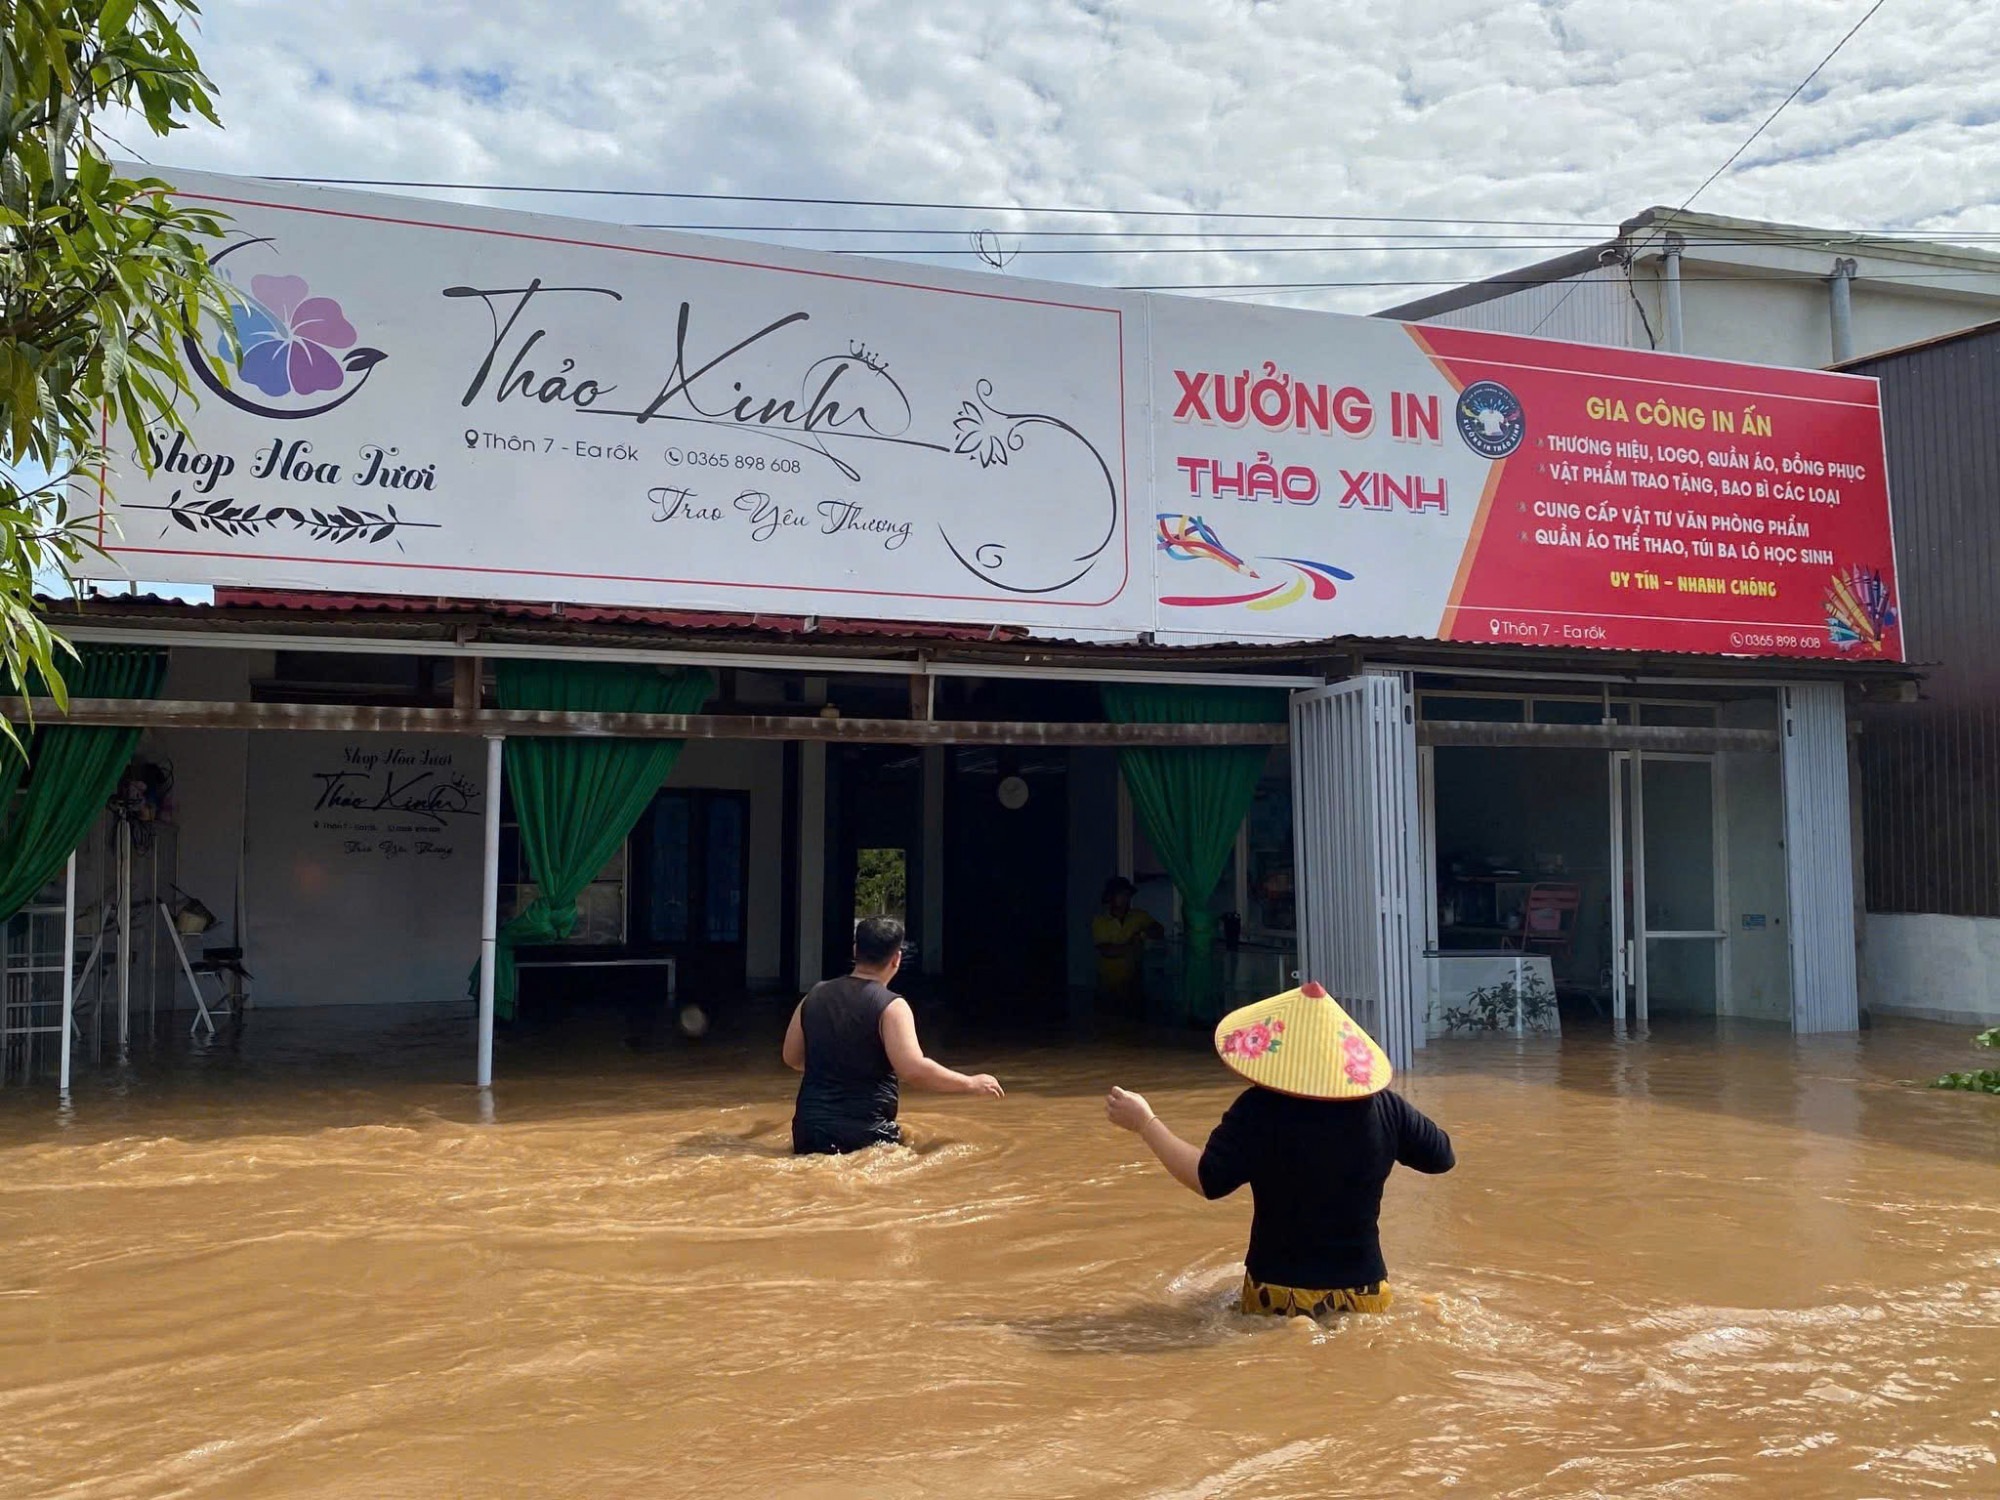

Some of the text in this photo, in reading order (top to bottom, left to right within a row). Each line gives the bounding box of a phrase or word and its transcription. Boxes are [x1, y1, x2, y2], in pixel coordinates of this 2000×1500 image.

[443, 278, 911, 437] Thảo Xinh
[1173, 361, 1442, 444] XƯỞNG IN
[1586, 396, 1772, 437] GIA CÔNG IN ẤN
[131, 428, 438, 493] Shop Hoa Tươi
[483, 432, 536, 452] Thôn
[543, 438, 555, 453] 7
[687, 451, 801, 474] 0365 898 608
[1547, 435, 1867, 483] THƯƠNG HIỆU, LOGO, QUẦN ÁO, ĐỒNG PHỤC
[1177, 451, 1448, 514] THẢO XINH
[1550, 460, 1841, 508] VẬT PHẨM TRAO TẶNG, BAO BÌ CÁC LOẠI
[648, 485, 913, 550] Trao Yêu Thương
[1533, 500, 1810, 537] CUNG CẤP VẬT TƯ VĂN PHÒNG PHẨM
[1535, 523, 1834, 566] QUẦN ÁO THỂ THAO, TÚI BA LÔ HỌC SINH
[1610, 571, 1630, 588] UY
[1634, 569, 1659, 590] TÍN
[1677, 576, 1726, 595] NHANH
[1731, 576, 1777, 598] CHÓNG
[1501, 621, 1538, 636] Thôn
[1541, 623, 1550, 636] 7
[1745, 633, 1821, 649] 0365 898 608
[344, 747, 379, 771] Shop
